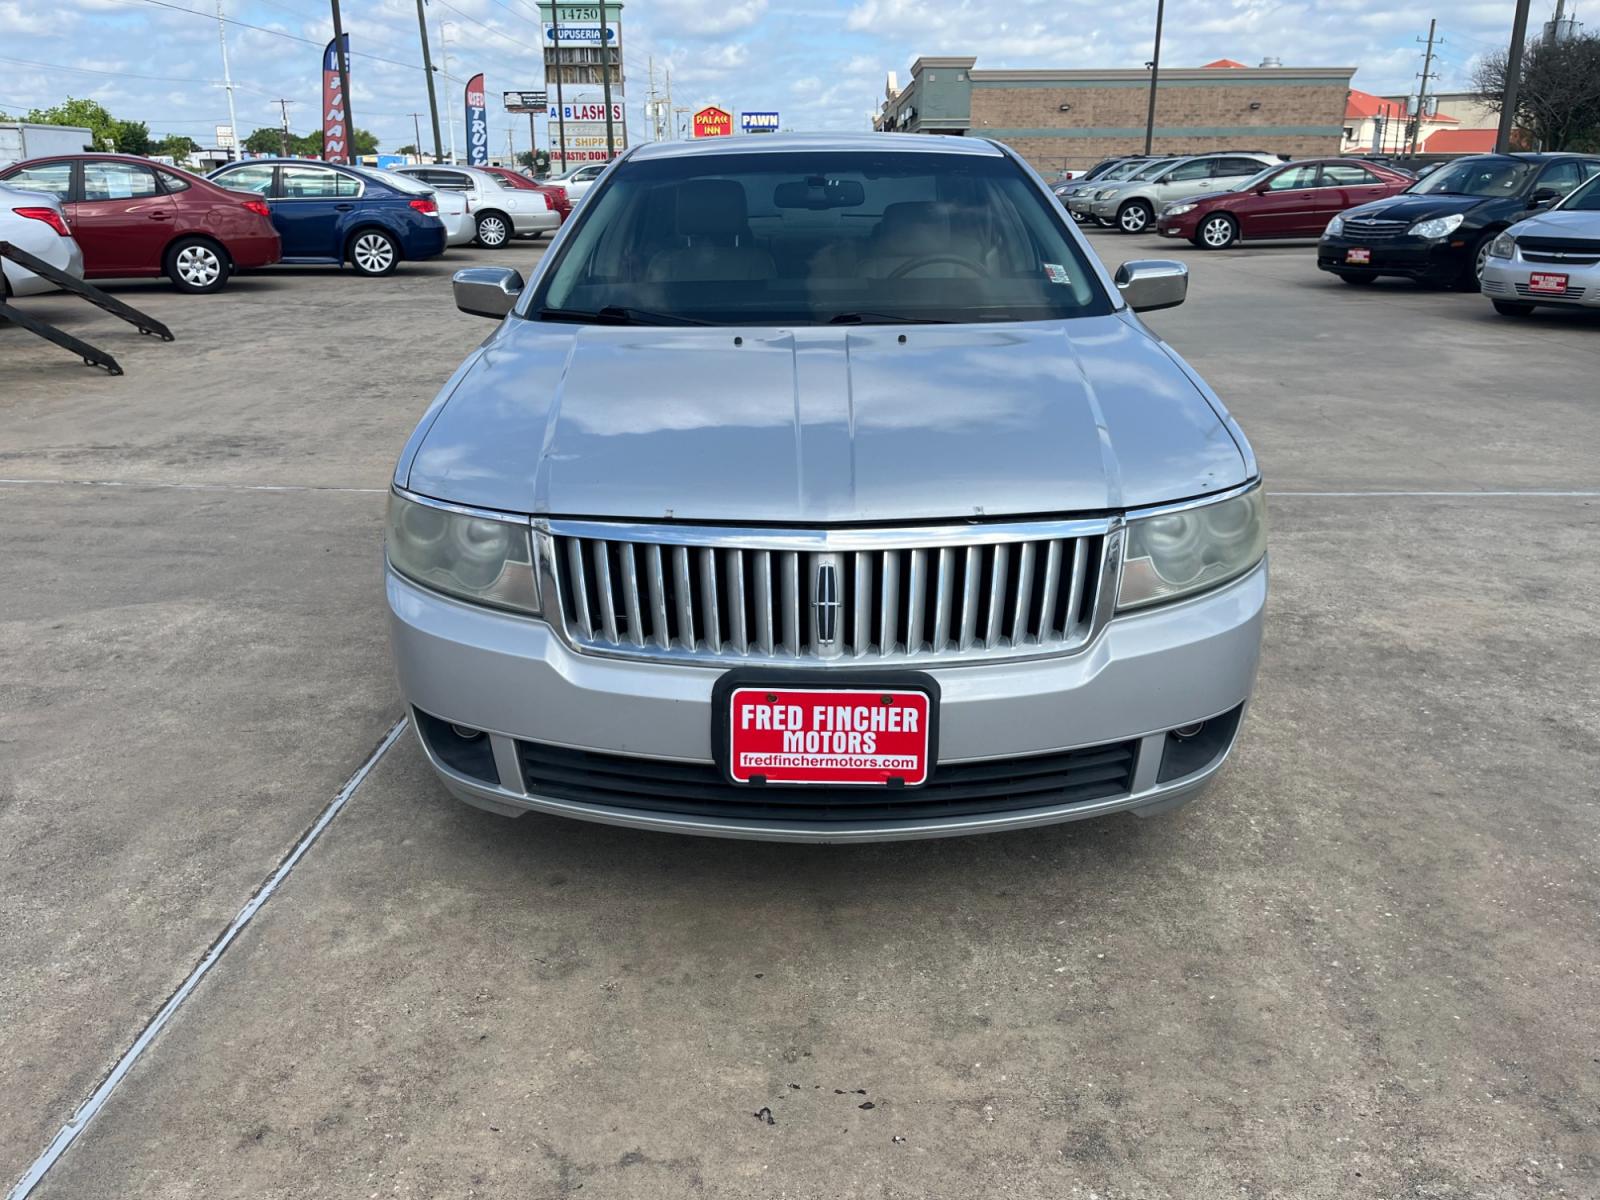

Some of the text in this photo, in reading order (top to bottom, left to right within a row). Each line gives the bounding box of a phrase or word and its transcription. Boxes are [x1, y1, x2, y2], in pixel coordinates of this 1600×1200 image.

[561, 8, 598, 20] 14750
[553, 29, 601, 39] UPUSERIA
[573, 105, 621, 120] LASHS
[743, 114, 778, 126] PAWN
[704, 125, 721, 135] INN
[575, 138, 624, 147] SHIPPIG
[741, 704, 919, 733] FRED FINCHER
[782, 730, 877, 754] MOTORS
[742, 753, 915, 769] fredfinchermotors.com
